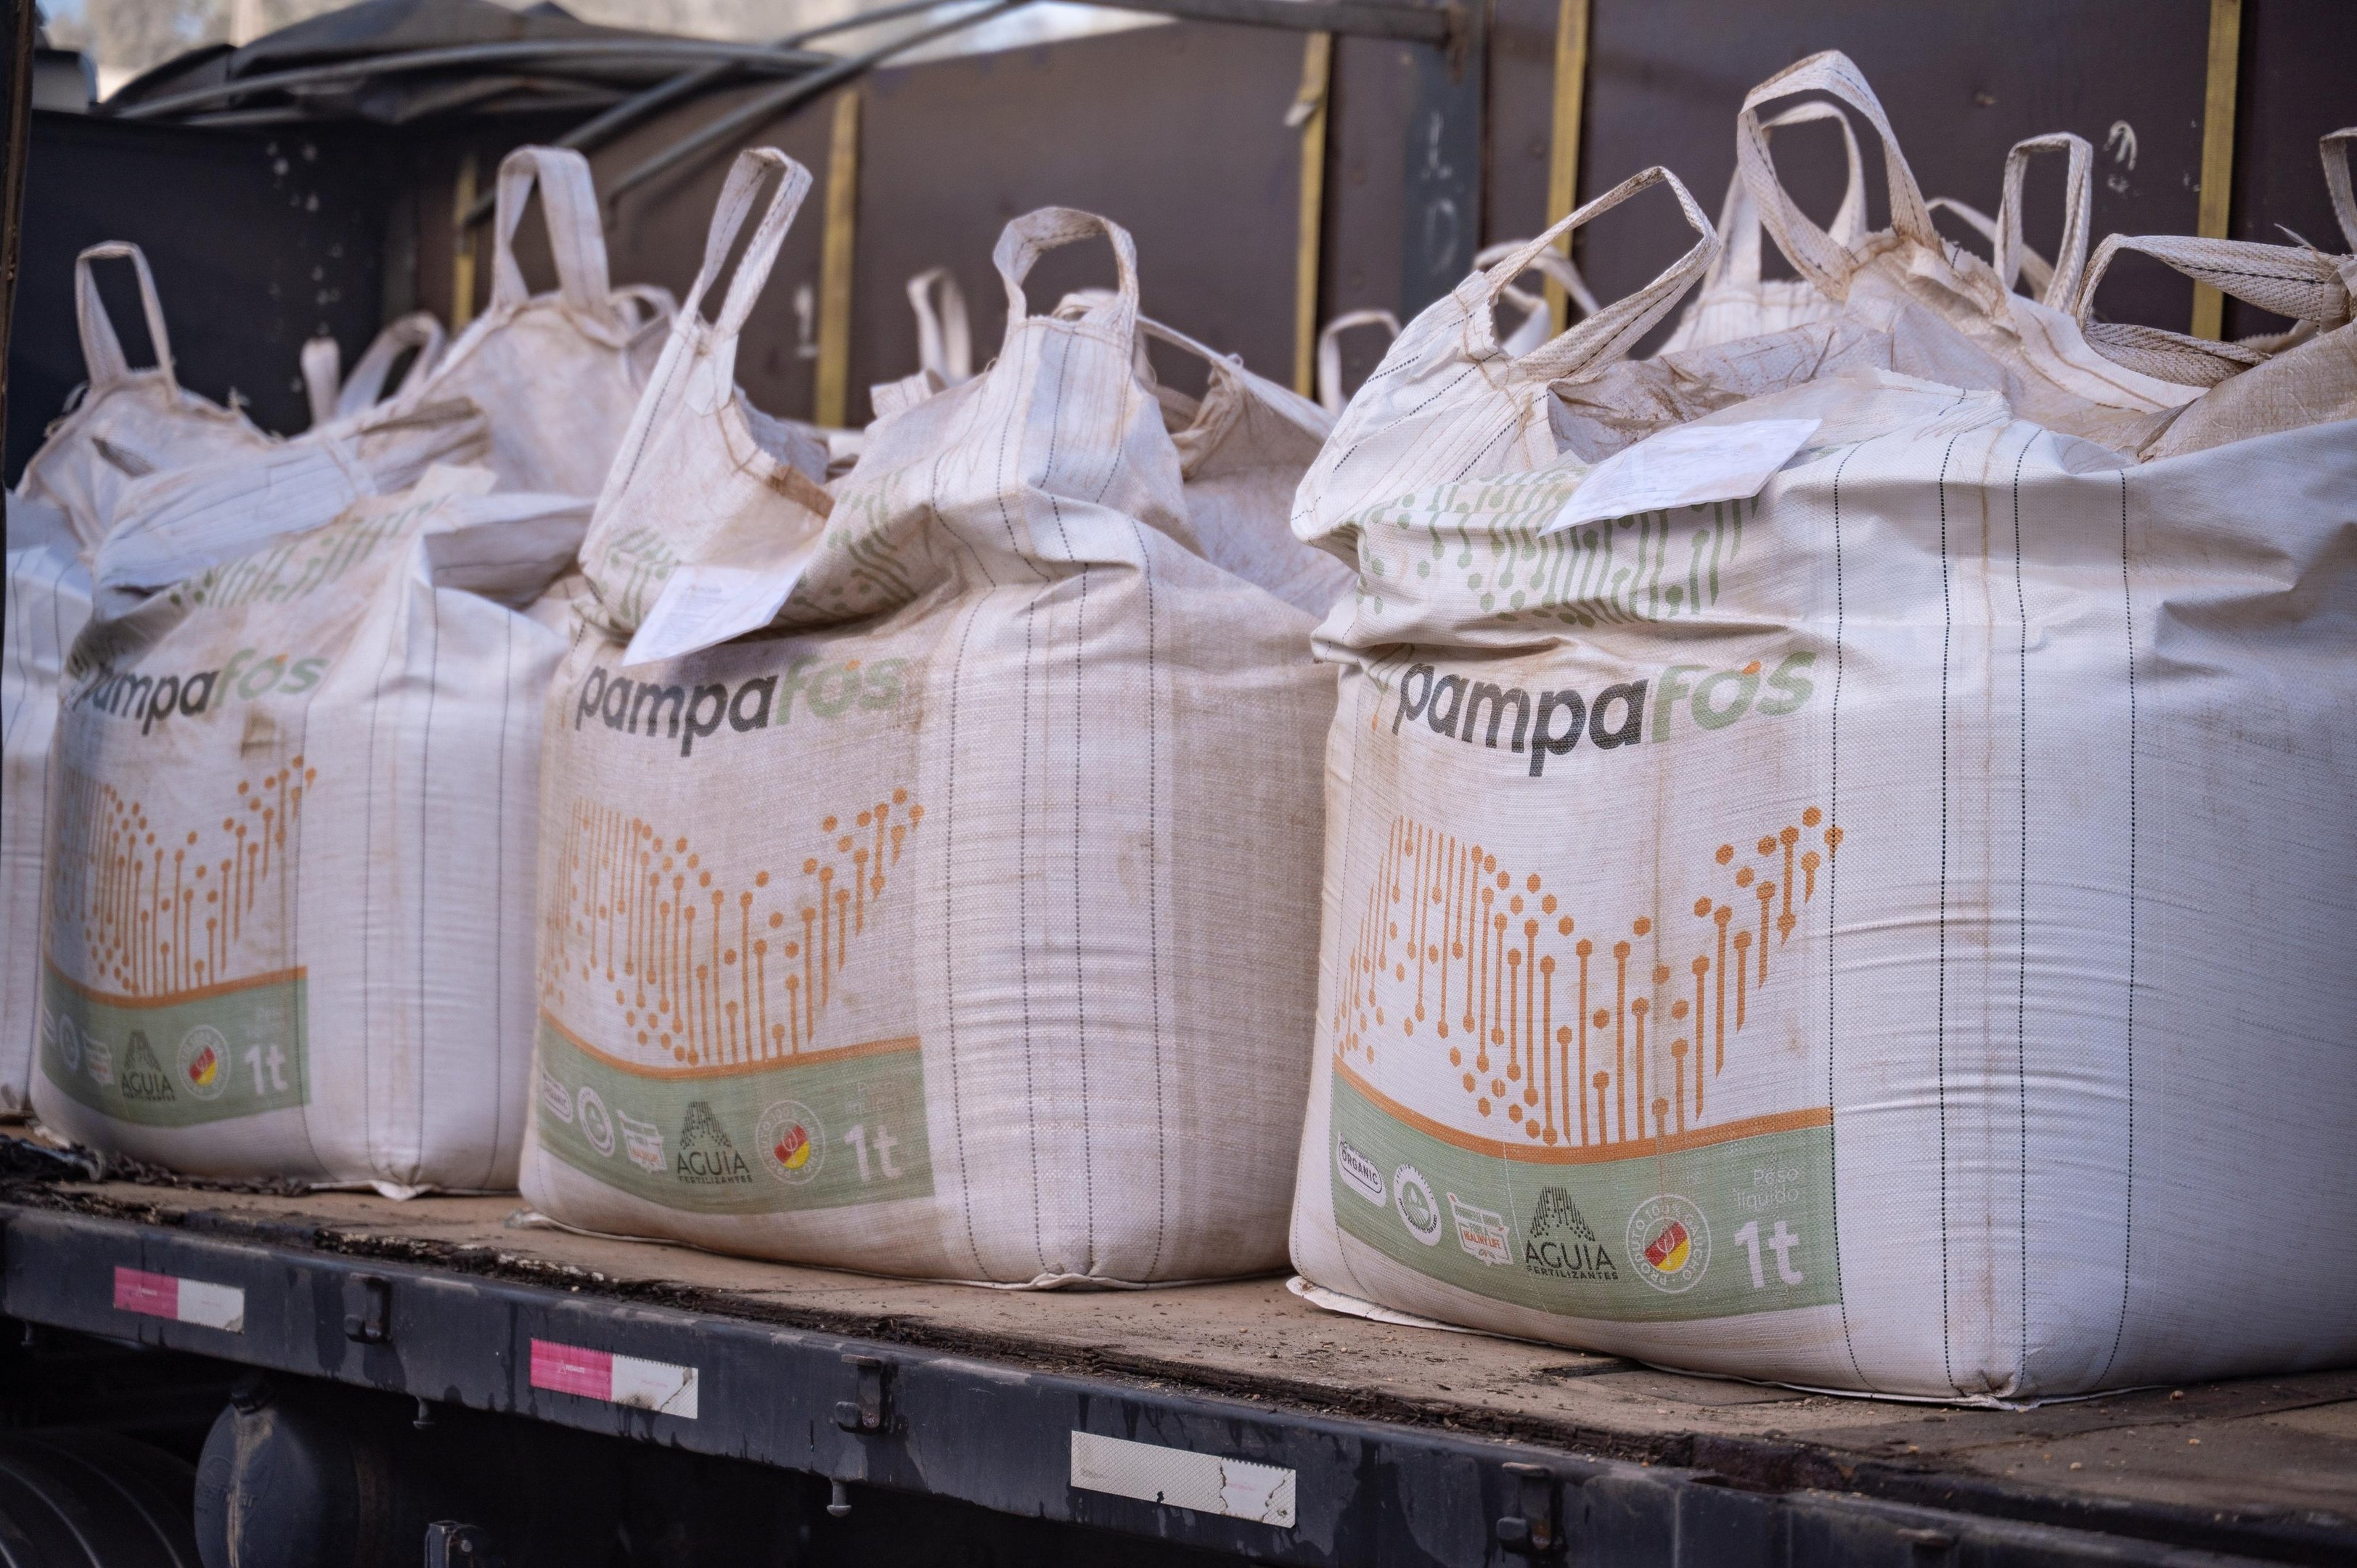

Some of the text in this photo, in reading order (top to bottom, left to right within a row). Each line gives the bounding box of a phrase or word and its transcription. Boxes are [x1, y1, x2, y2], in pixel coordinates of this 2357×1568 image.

[244, 1045, 288, 1096] 1t
[677, 1151, 749, 1175] AGUIA
[844, 1124, 903, 1184] 1t
[1342, 1149, 1378, 1185] ORGANIC
[1754, 1168, 1798, 1187] Peso
[1526, 1239, 1616, 1270] AGUIA
[1631, 1220, 1667, 1286] PRODUTO
[1734, 1221, 1804, 1289] 1t
[1526, 1265, 1619, 1280] FERTILIZANTES
